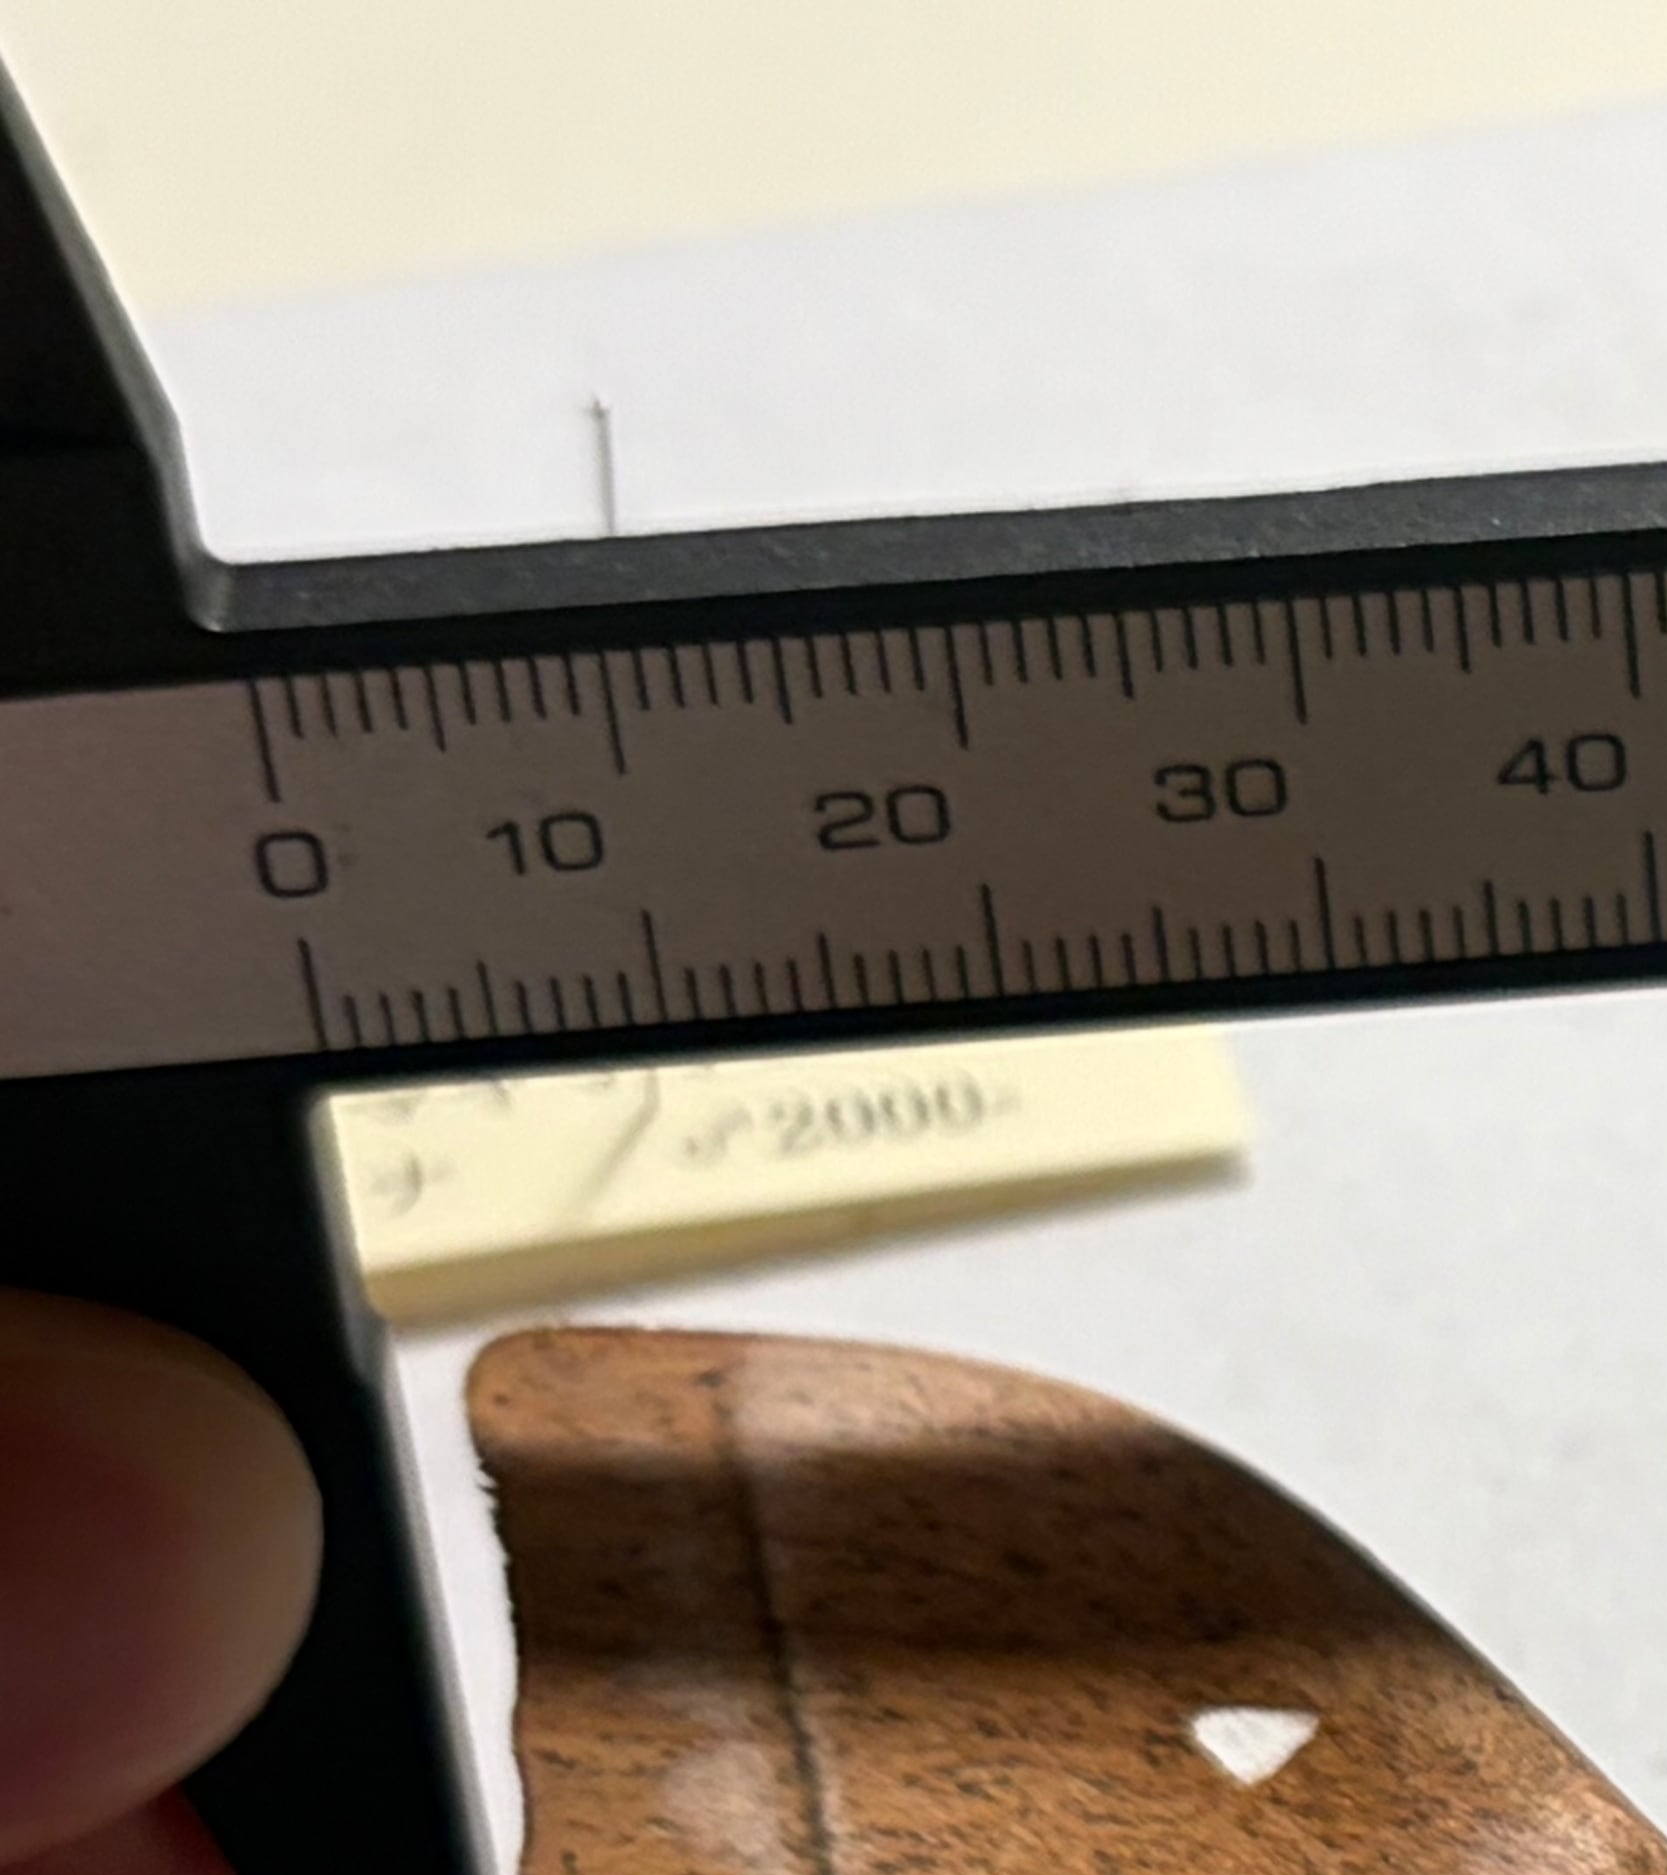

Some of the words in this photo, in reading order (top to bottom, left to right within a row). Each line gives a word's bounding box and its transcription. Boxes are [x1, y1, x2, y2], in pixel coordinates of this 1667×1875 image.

[254, 830, 329, 898] 0
[484, 810, 604, 874] 10
[814, 784, 953, 849] 20
[1154, 758, 1289, 822] 30
[1496, 732, 1628, 795] 40
